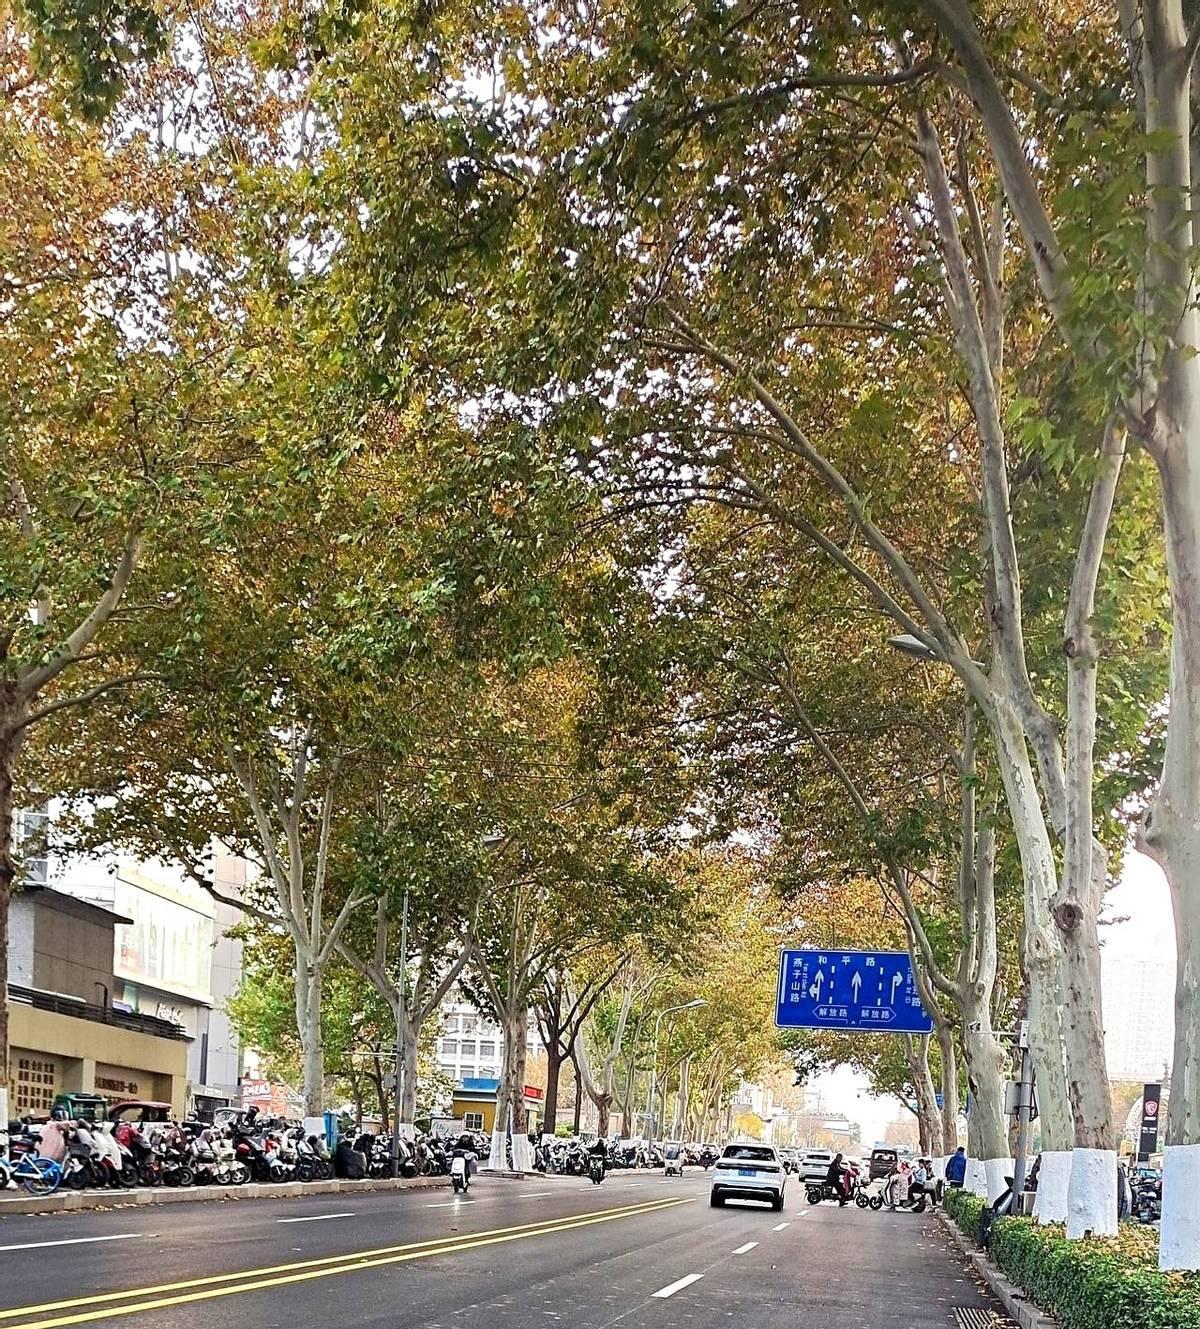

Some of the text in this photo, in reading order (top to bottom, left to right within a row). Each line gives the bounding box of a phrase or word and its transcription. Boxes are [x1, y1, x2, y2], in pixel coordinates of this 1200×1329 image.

[818, 955, 876, 967] 和平路
[790, 958, 803, 1003] 燕子山路
[818, 1007, 848, 1018] 解放路
[861, 1009, 890, 1019] 解放路
